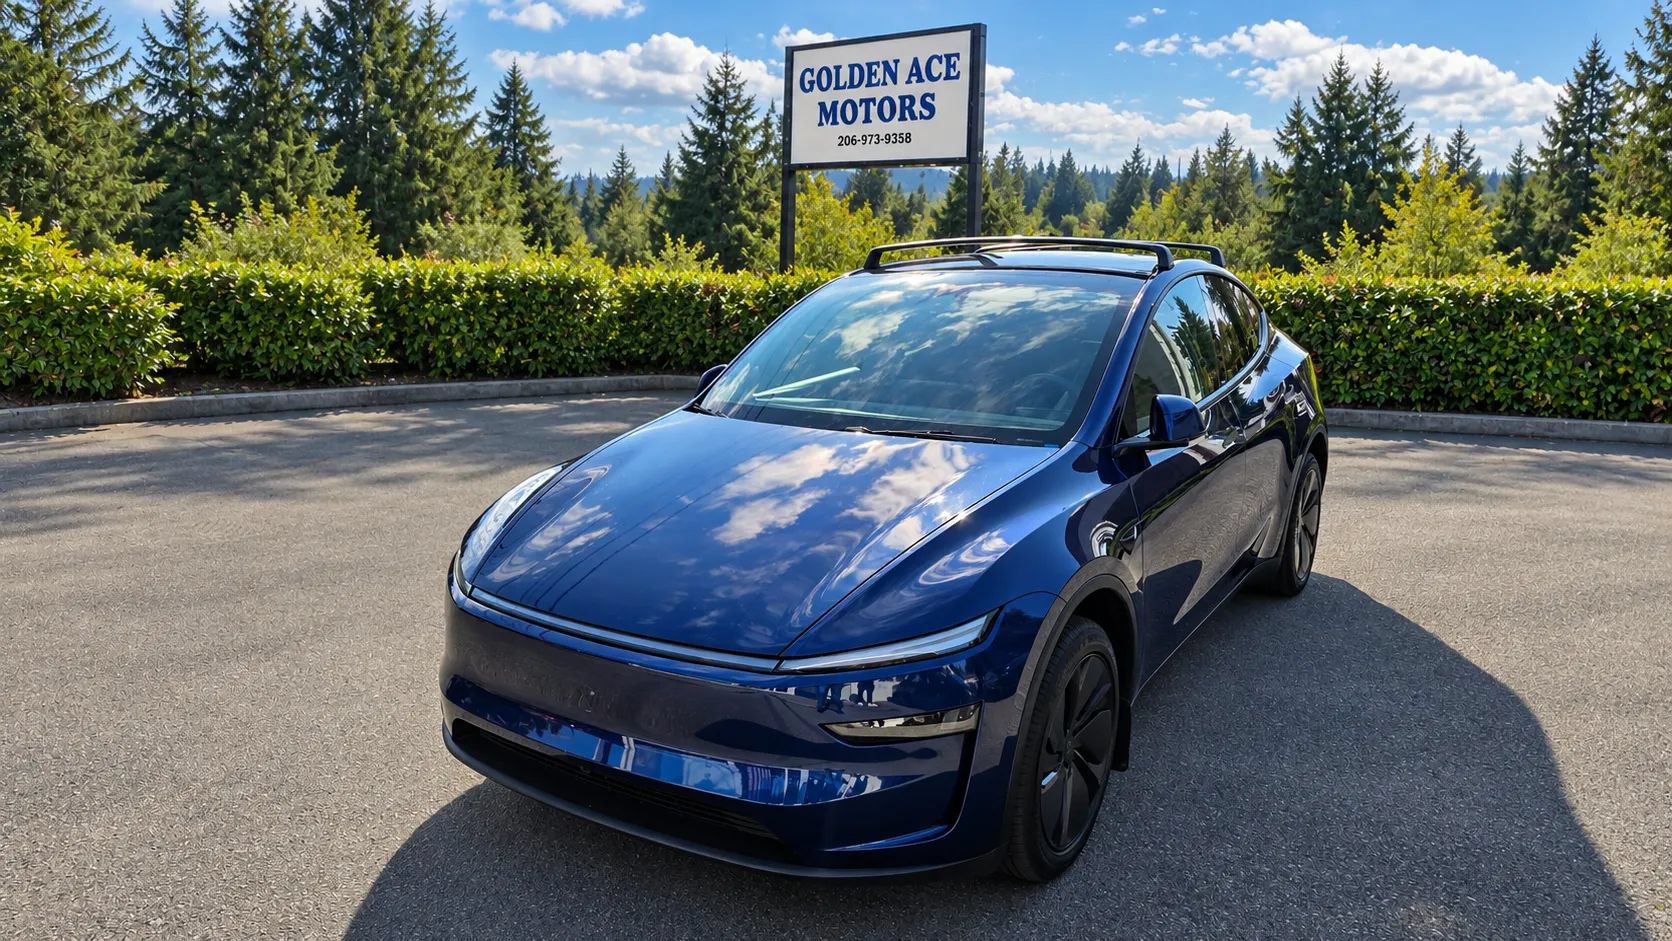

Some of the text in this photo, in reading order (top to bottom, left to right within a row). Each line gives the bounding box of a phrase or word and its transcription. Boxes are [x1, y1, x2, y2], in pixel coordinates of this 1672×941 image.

[799, 52, 960, 93] GOLDEN ACE
[817, 92, 936, 127] MOTORS
[837, 132, 912, 147] 206-973-9358
